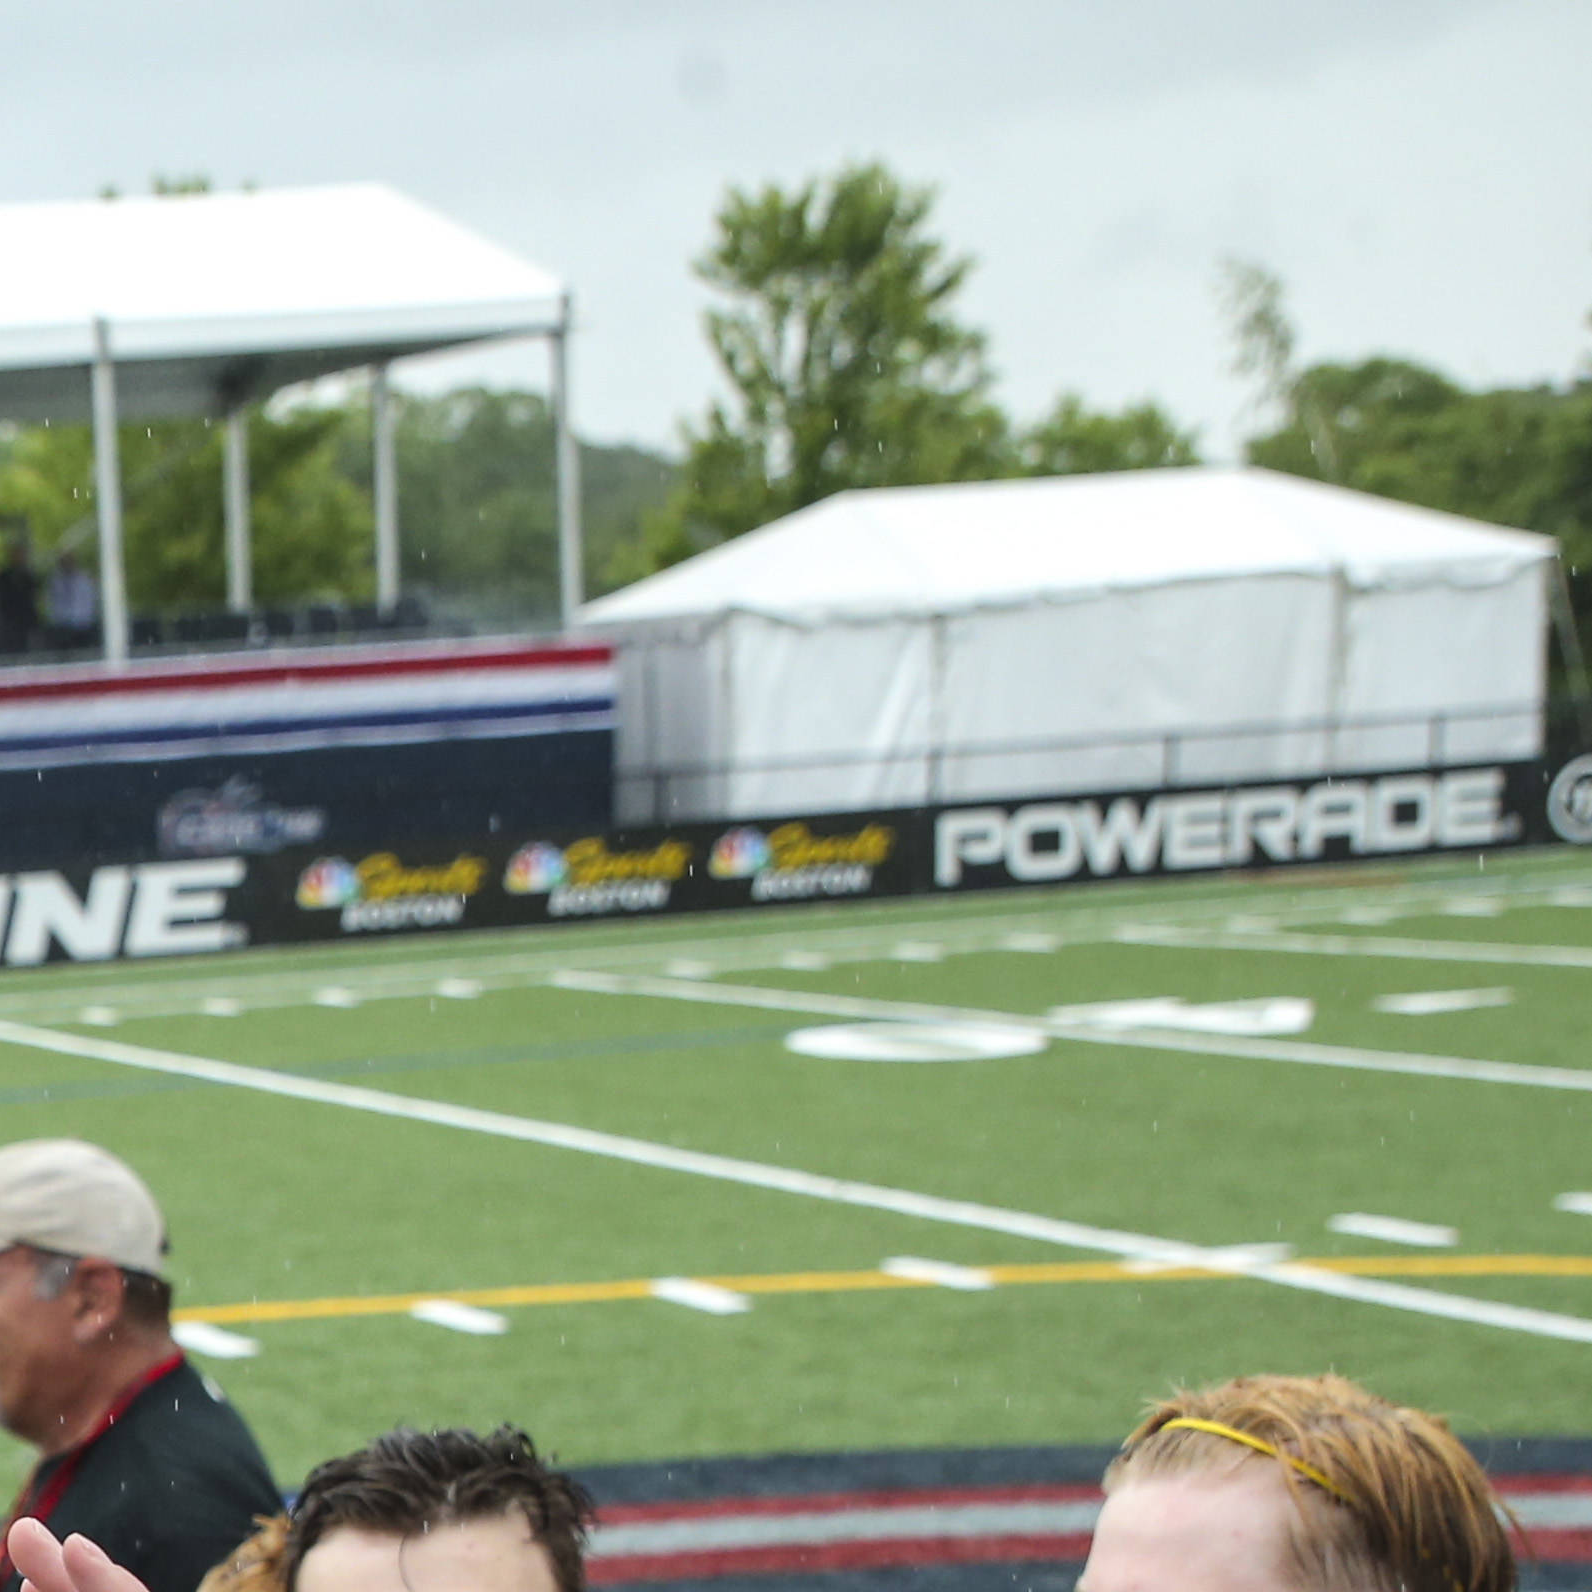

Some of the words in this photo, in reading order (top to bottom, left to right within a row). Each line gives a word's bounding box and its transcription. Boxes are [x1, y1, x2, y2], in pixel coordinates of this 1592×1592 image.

[933, 767, 1505, 889] POWERADE
[547, 879, 672, 918] BOSTON
[752, 864, 873, 902] BOSTON
[341, 893, 466, 934] BOSTON
